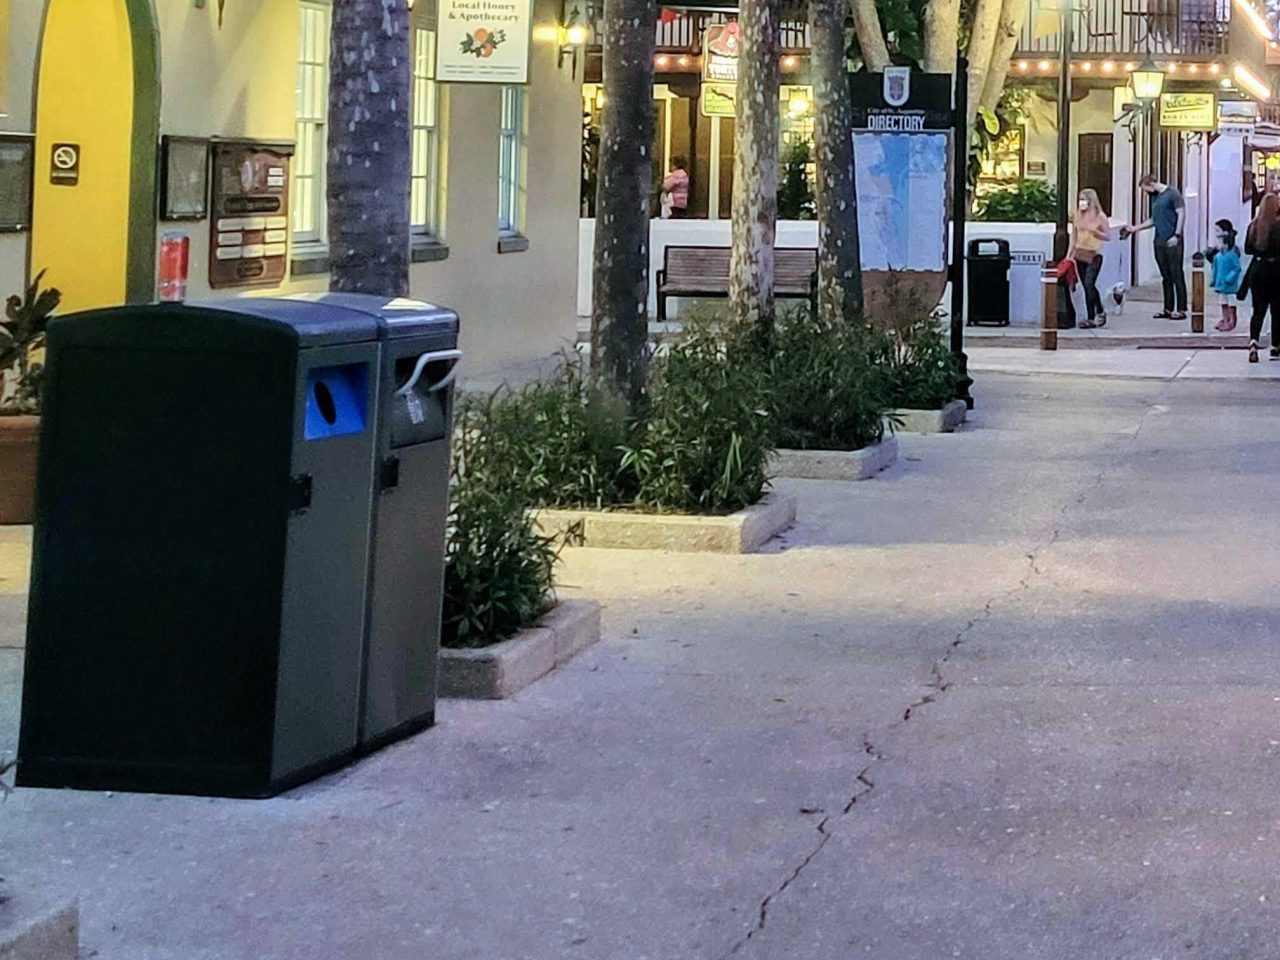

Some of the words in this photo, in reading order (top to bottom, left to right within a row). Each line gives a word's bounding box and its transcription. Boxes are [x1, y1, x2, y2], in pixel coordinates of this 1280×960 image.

[452, 1, 480, 9] Local
[483, 1, 516, 12] Honey
[448, 11, 456, 19] &
[458, 11, 519, 24] Apothecary
[867, 115, 926, 130] DIRECTORY
